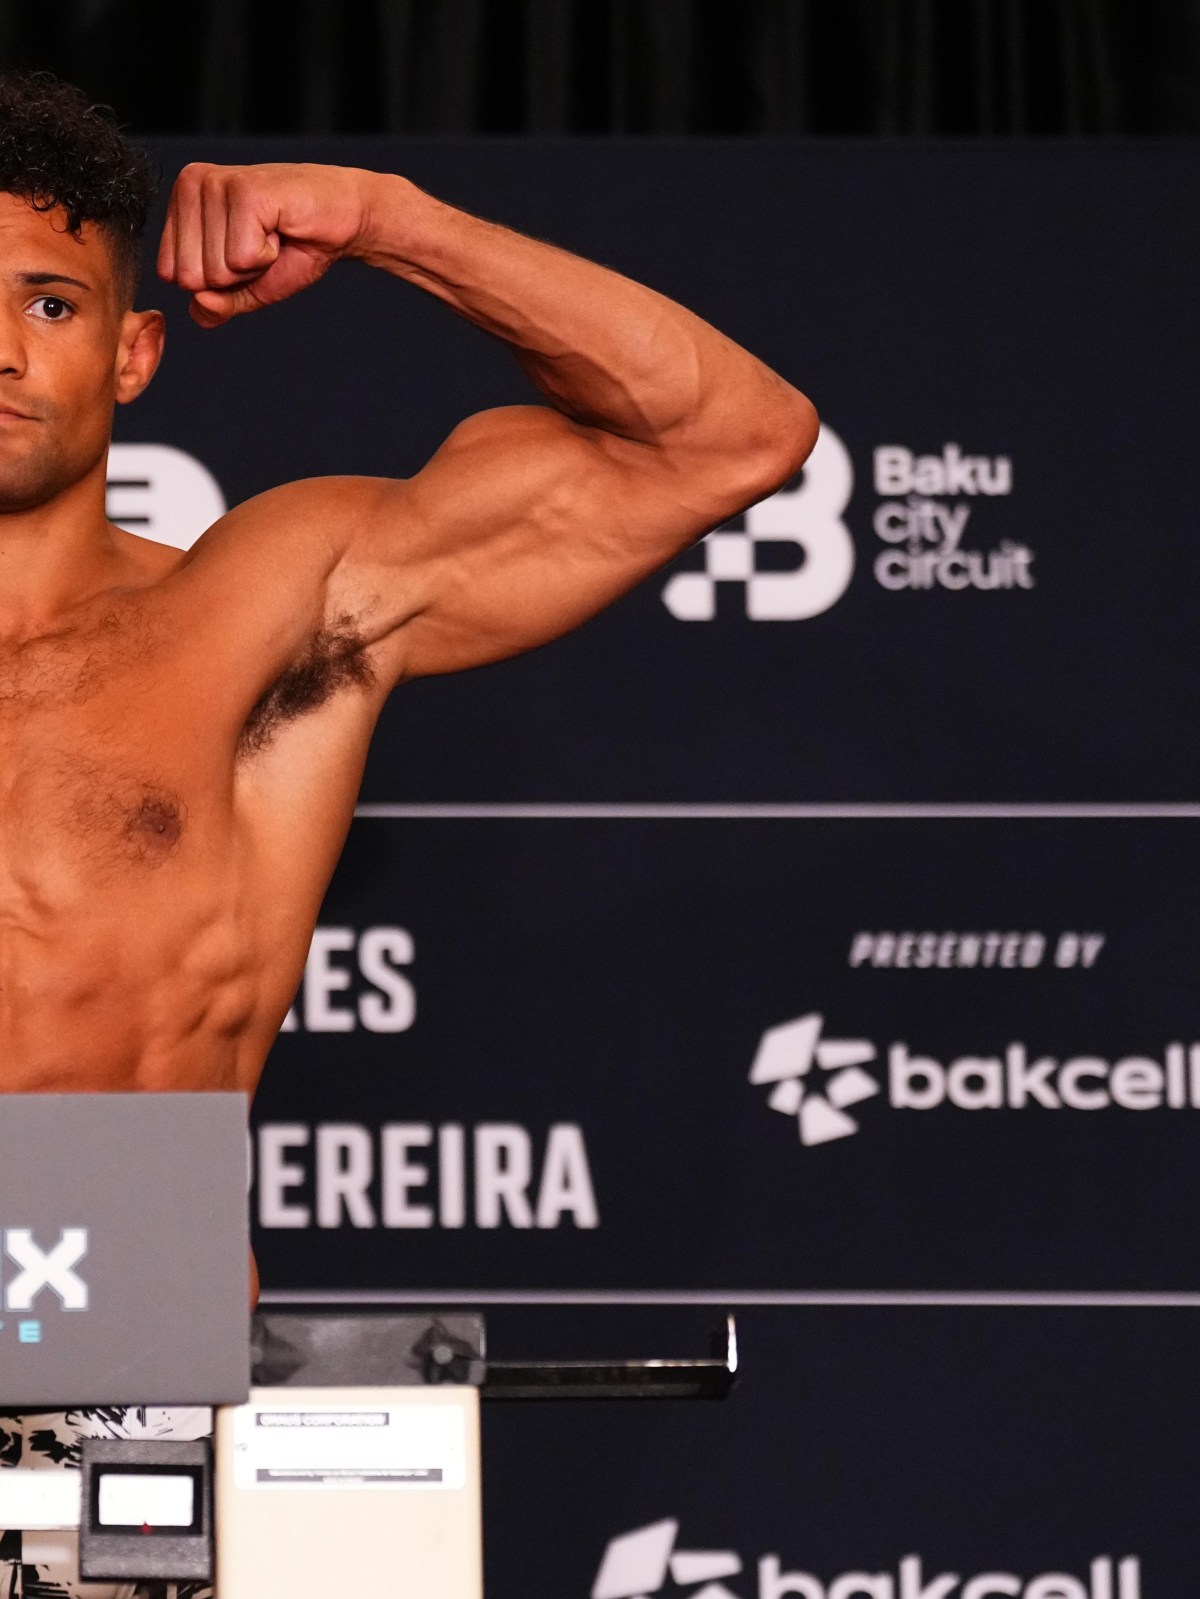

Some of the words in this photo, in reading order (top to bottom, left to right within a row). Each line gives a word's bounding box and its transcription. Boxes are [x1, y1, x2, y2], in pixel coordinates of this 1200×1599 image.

[873, 442, 1012, 496] Baku
[873, 498, 970, 556] city
[873, 541, 1034, 590] circuit
[848, 931, 1046, 969] PRESENTED
[1054, 931, 1105, 969] BY
[279, 927, 416, 1033] ES
[888, 1041, 1200, 1110] bakcell
[250, 1123, 599, 1230] EREIRA
